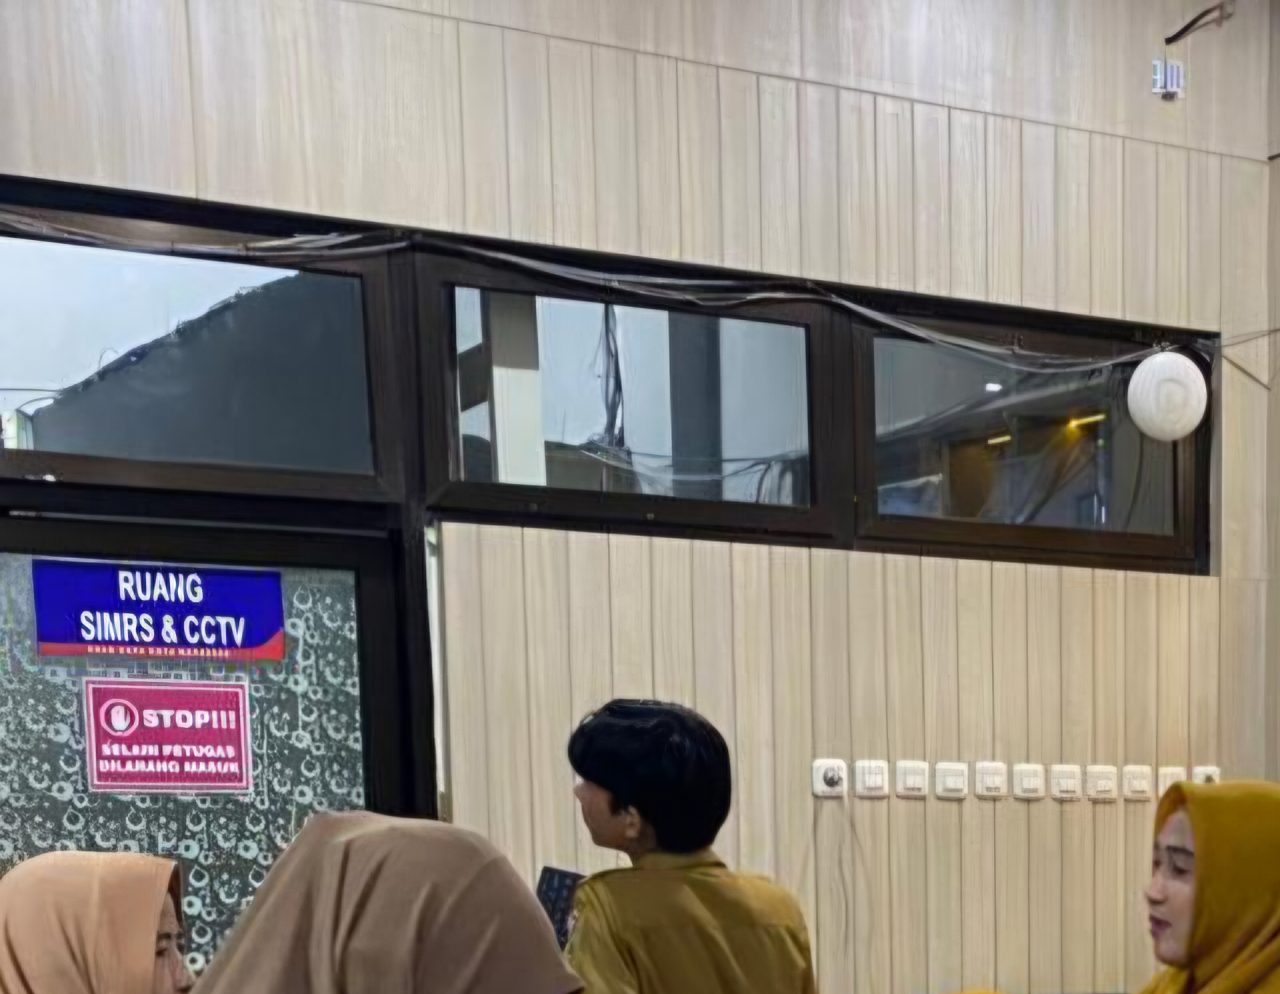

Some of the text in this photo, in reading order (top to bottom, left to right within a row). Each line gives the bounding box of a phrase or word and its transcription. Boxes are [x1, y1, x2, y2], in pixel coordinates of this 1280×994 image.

[119, 570, 204, 603] RUANG
[80, 611, 245, 648] SIMRS & CCTV
